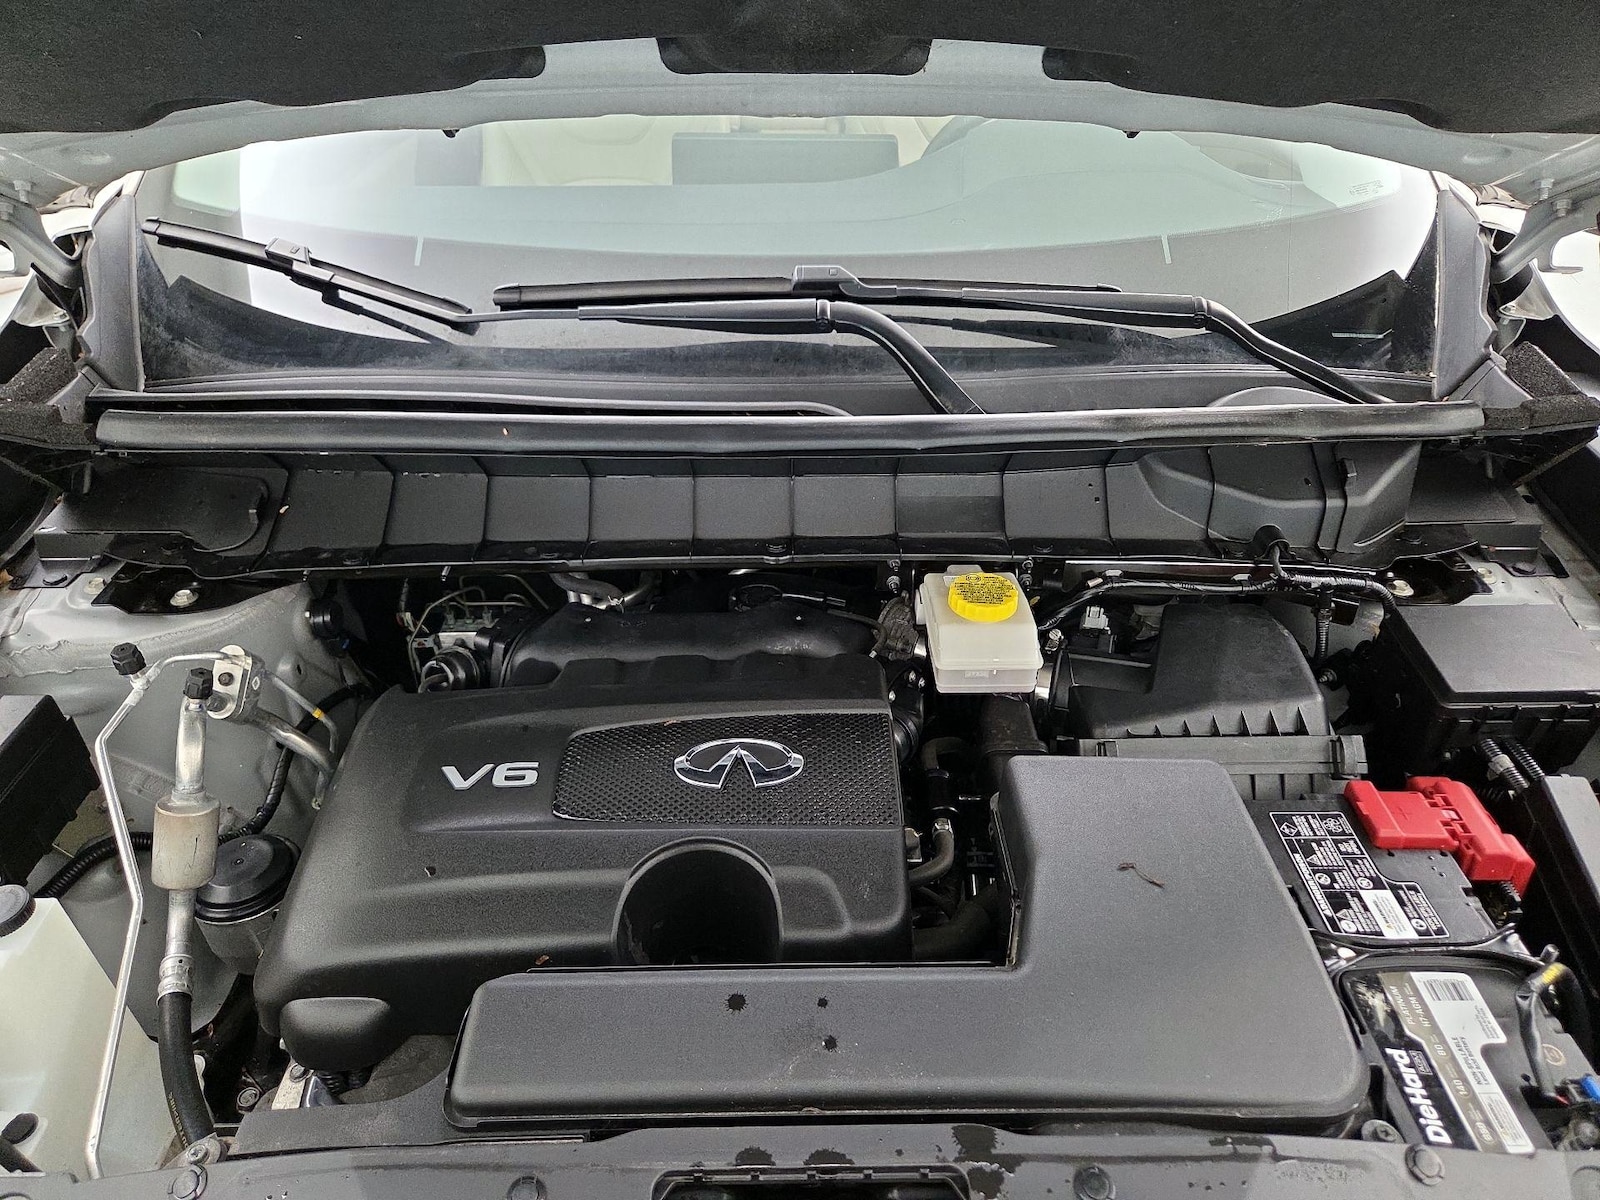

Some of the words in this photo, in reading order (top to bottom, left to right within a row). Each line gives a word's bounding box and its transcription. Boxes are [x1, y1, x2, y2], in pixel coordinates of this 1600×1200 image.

[441, 762, 539, 790] V6
[1389, 985, 1415, 1025] PLATINUM
[1408, 996, 1431, 1027] H7-AGM
[1434, 1044, 1447, 1056] 80
[1385, 1048, 1452, 1144] DieHard
[1453, 1080, 1468, 1095] 140
